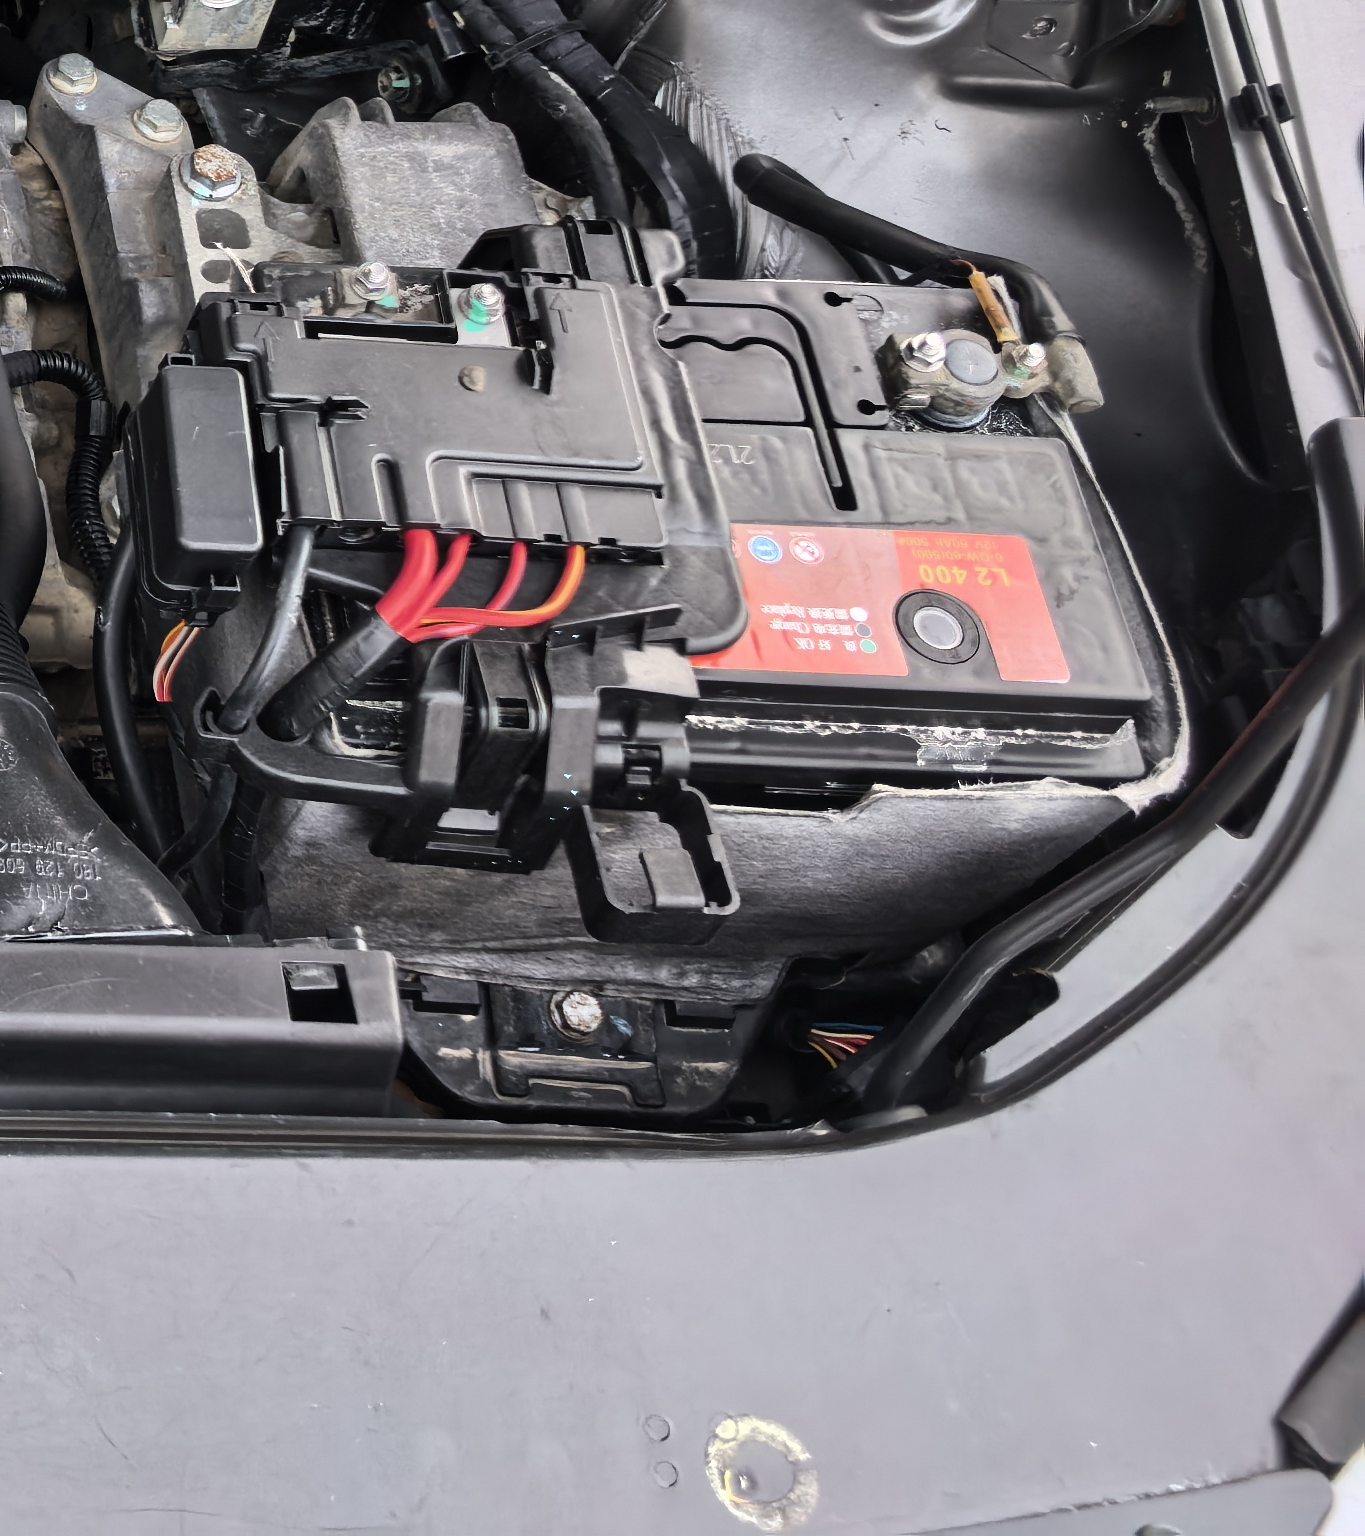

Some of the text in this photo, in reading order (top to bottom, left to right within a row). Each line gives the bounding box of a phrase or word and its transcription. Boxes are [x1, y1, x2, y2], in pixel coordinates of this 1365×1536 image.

[919, 565, 1010, 587] L2 400
[760, 603, 805, 618] Replace
[793, 637, 815, 651] OK
